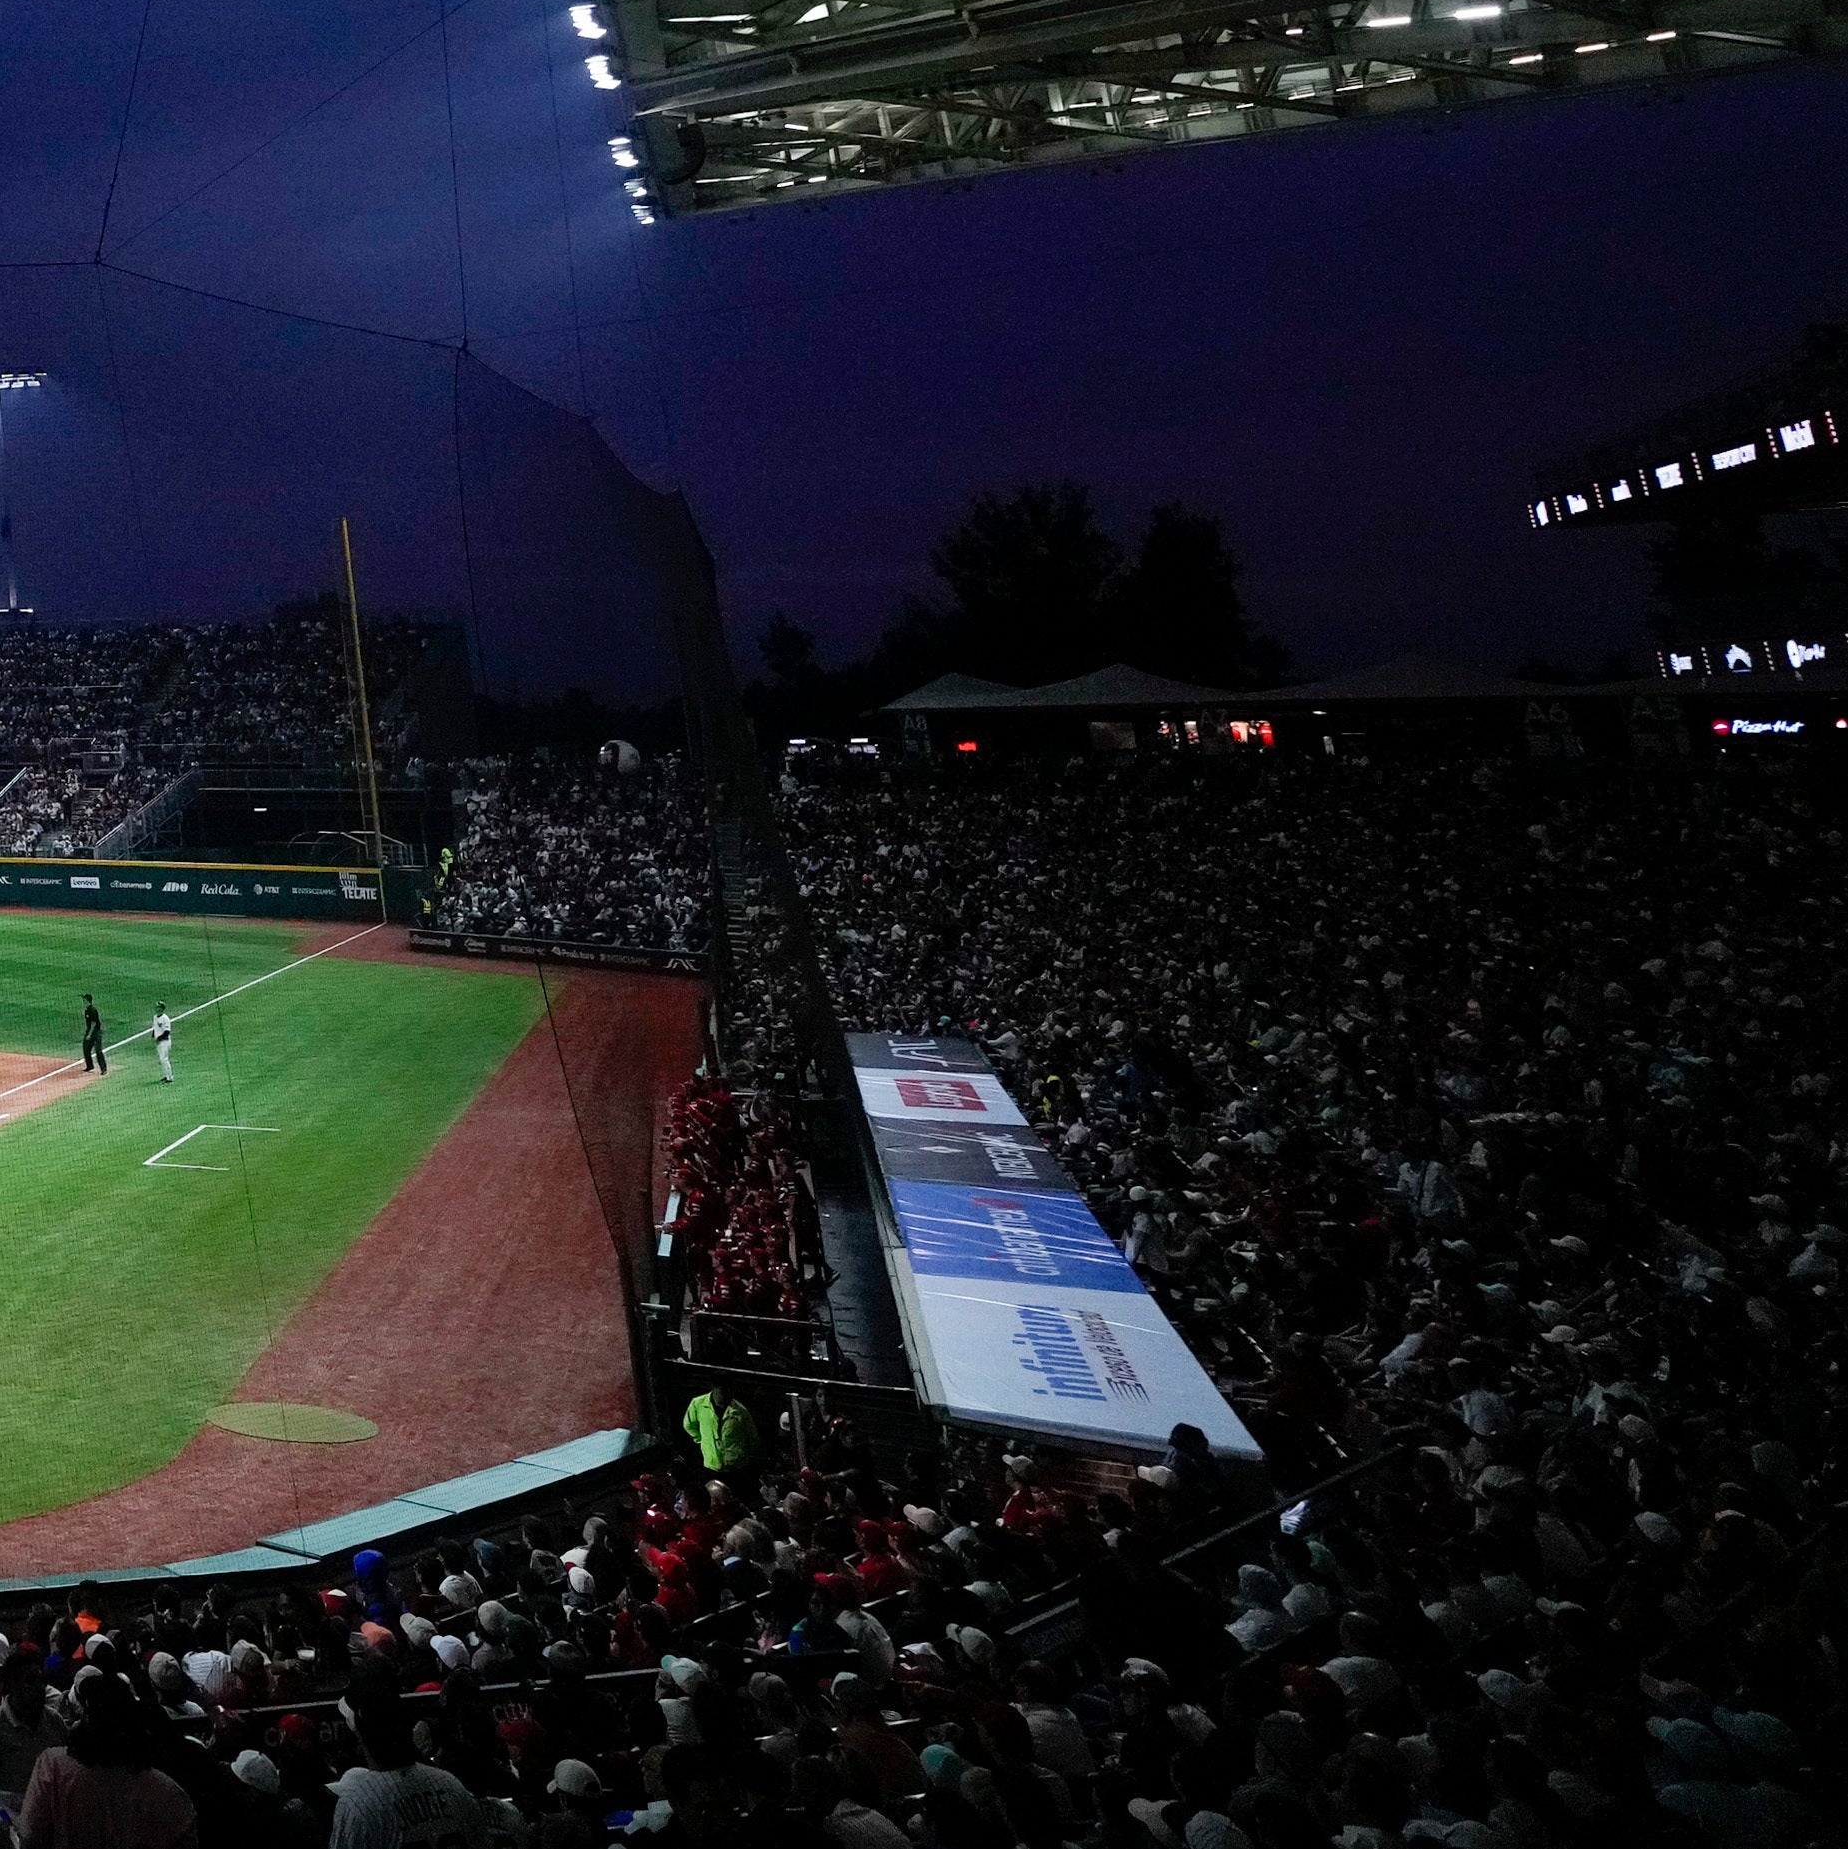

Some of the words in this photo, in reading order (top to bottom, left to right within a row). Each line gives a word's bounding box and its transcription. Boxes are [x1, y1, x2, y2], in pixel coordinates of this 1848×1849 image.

[1731, 719, 1771, 734] Pizza
[1772, 719, 1805, 734] Hut
[72, 878, 98, 887] Lenovo
[341, 886, 378, 901] TECATE
[988, 1207, 1061, 1276] citibanamex
[1012, 1304, 1108, 1402] infinitum
